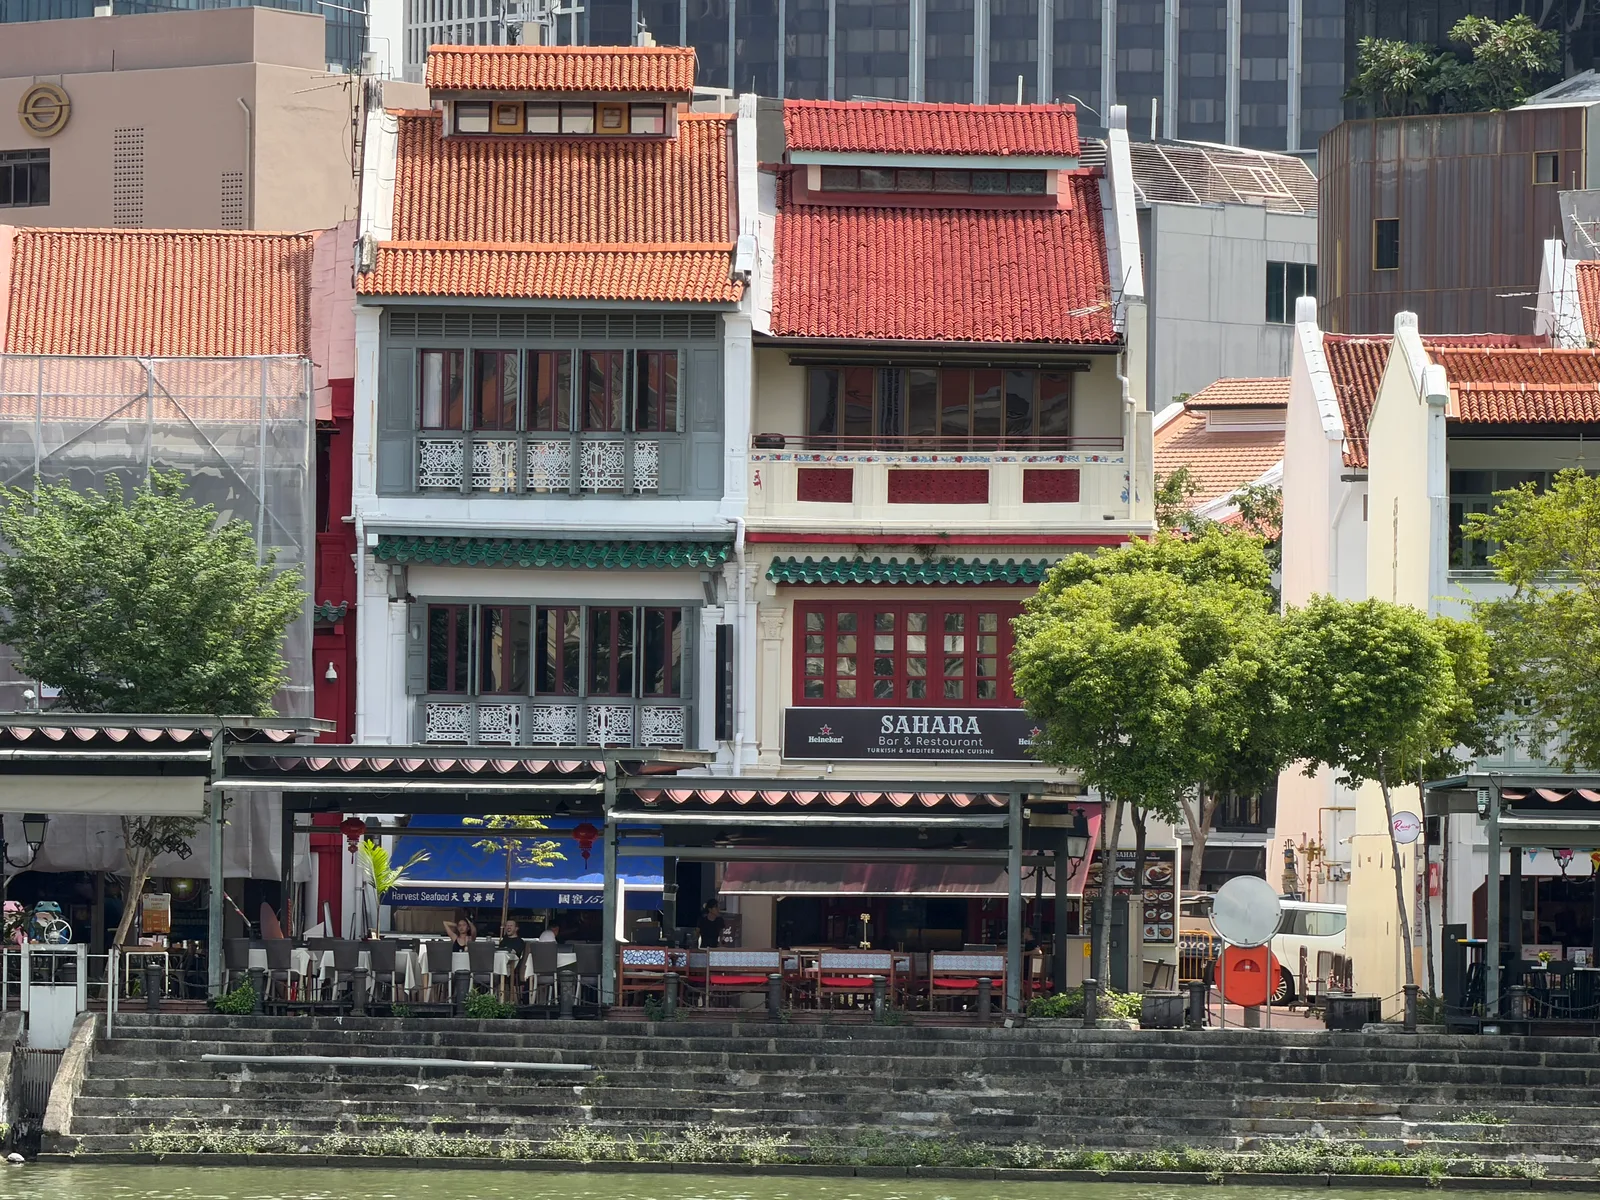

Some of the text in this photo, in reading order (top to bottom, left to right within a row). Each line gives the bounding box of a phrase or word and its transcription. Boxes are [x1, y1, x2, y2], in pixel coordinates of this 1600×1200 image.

[881, 715, 982, 735] SAHARA
[878, 736, 983, 747] Bar & Restaurant
[392, 891, 419, 901] Harvest
[420, 891, 450, 902] Seafood
